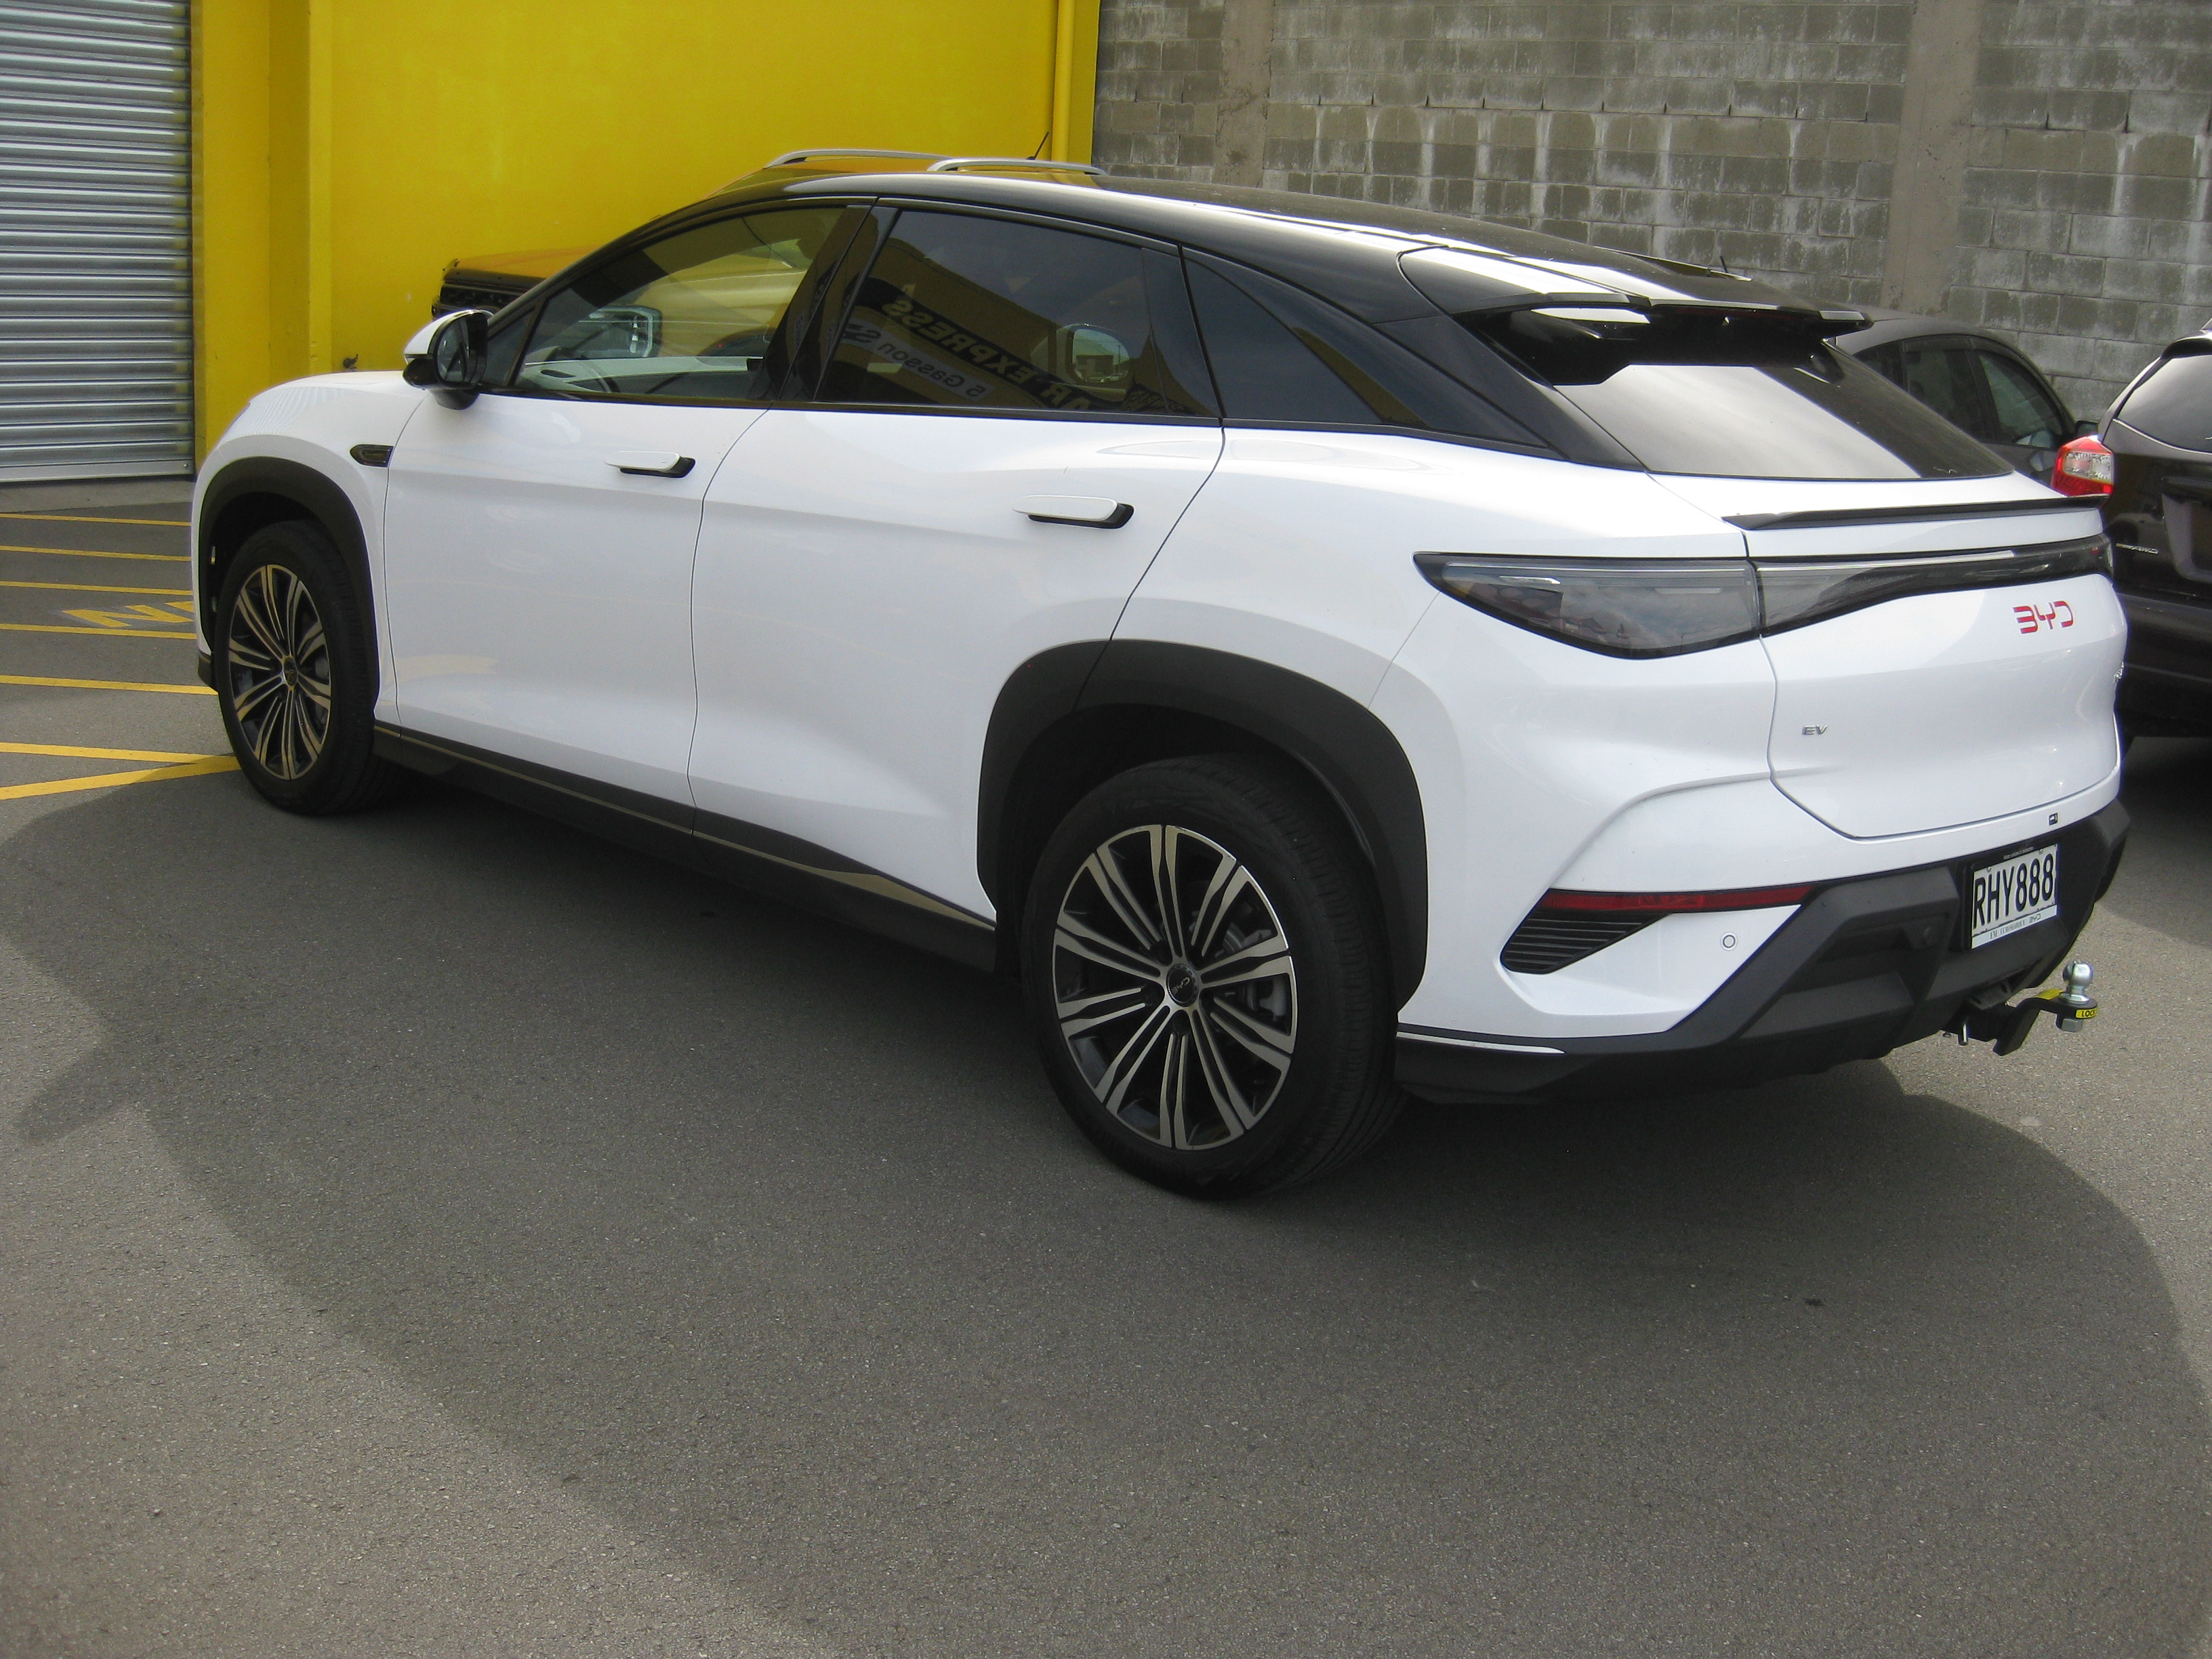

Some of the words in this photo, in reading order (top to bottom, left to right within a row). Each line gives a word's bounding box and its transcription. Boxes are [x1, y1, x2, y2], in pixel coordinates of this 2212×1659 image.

[2012, 600, 2074, 634] BYD
[1801, 724, 1828, 736] EV
[1973, 853, 2054, 930] RHY888
